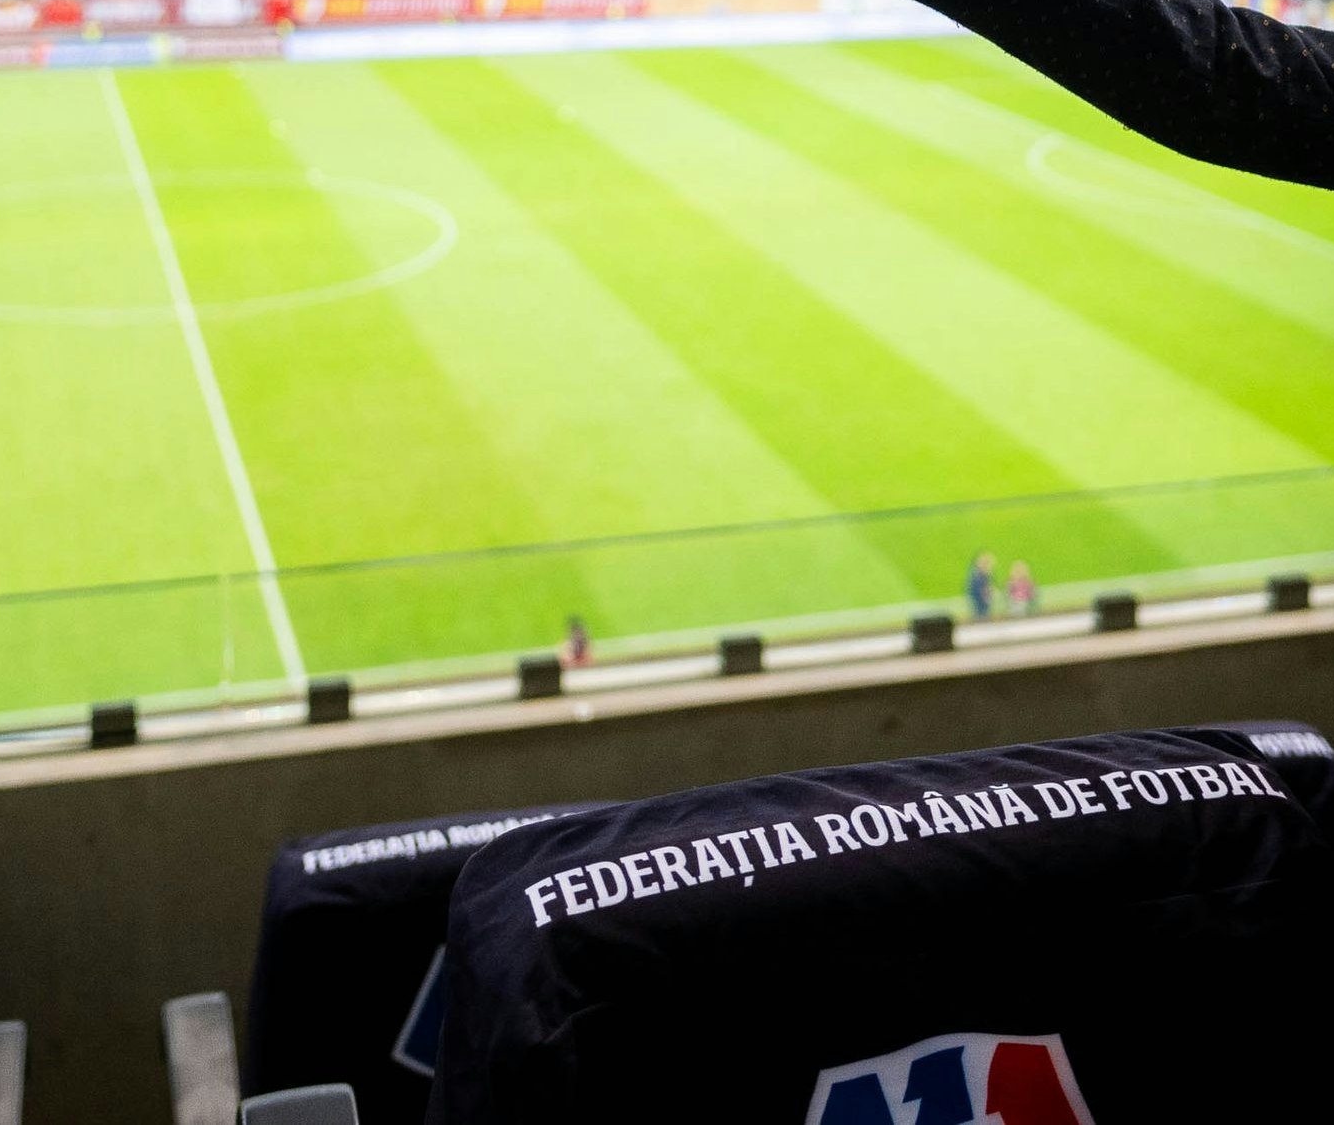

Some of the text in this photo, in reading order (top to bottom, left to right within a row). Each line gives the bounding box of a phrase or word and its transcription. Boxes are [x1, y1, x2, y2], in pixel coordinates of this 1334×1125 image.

[524, 762, 1287, 928] FEDERAȚIA ROMÂNĂ DE FOTBAL
